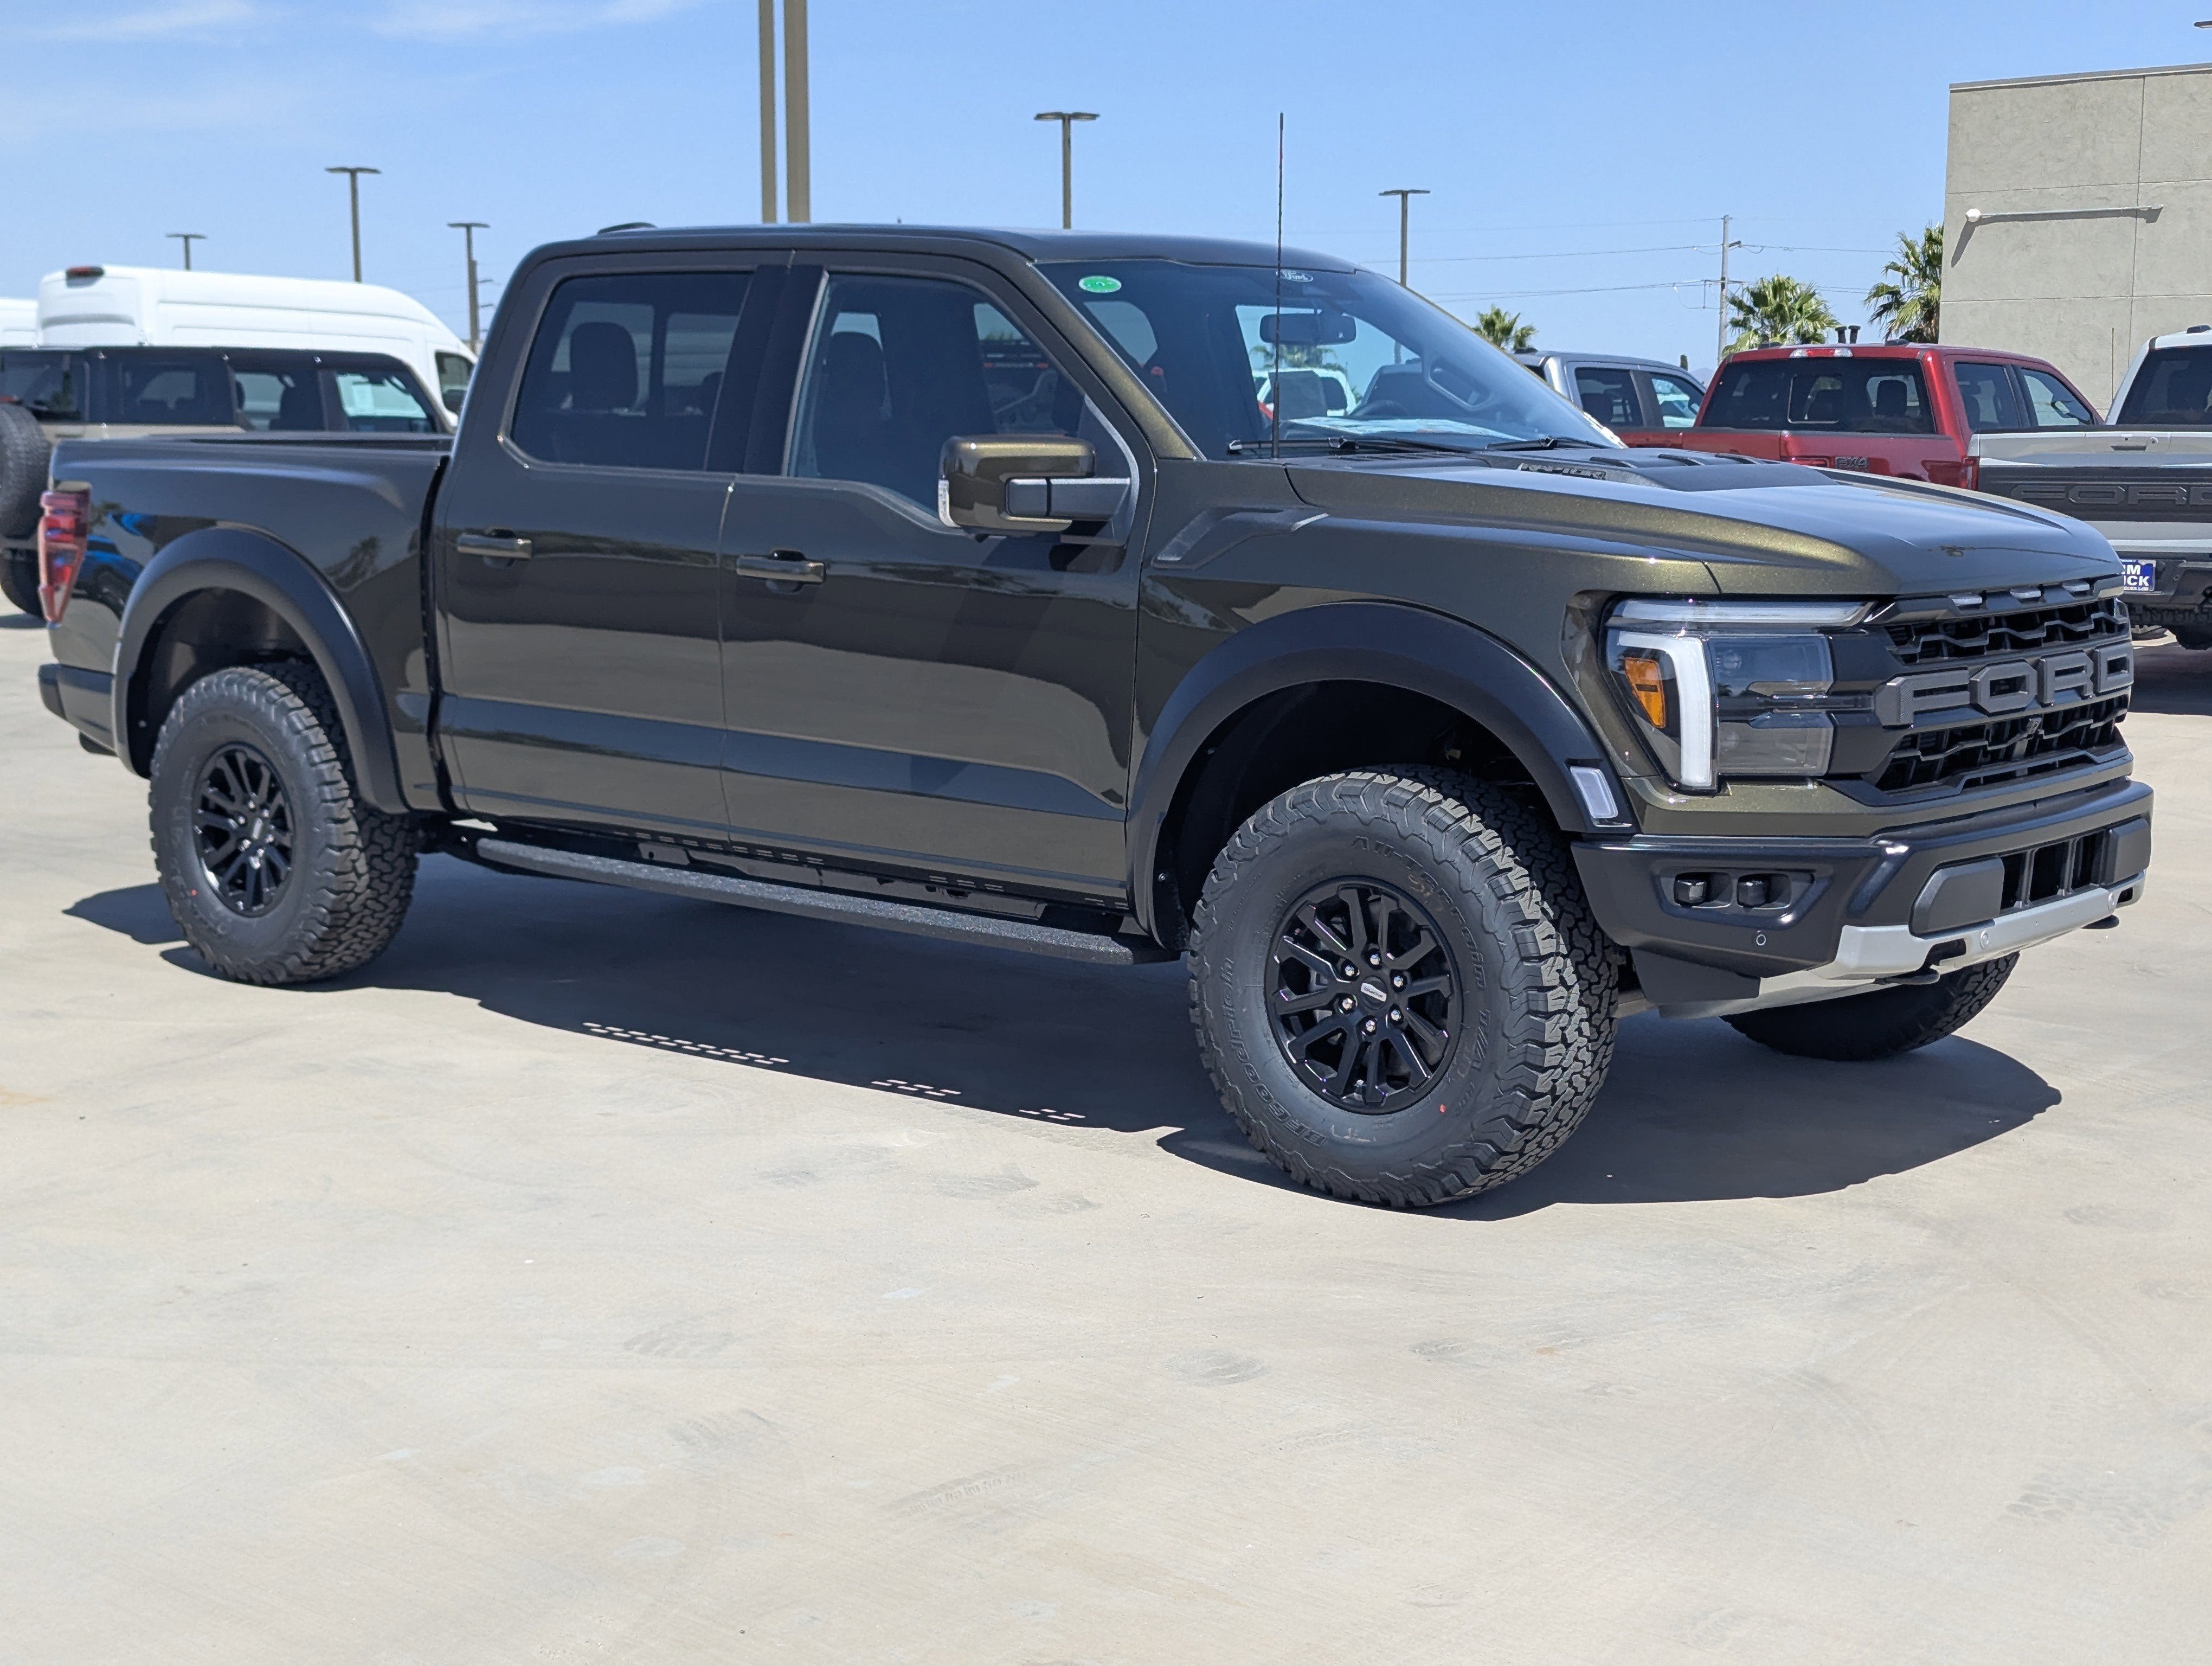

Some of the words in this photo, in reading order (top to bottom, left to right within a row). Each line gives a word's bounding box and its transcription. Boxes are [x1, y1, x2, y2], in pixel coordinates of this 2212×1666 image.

[1835, 456, 1869, 470] FX4
[1873, 645, 2134, 728] FORD
[1351, 835, 1487, 989] All-Terrain
[1220, 957, 1328, 1148] BFGoodrich
